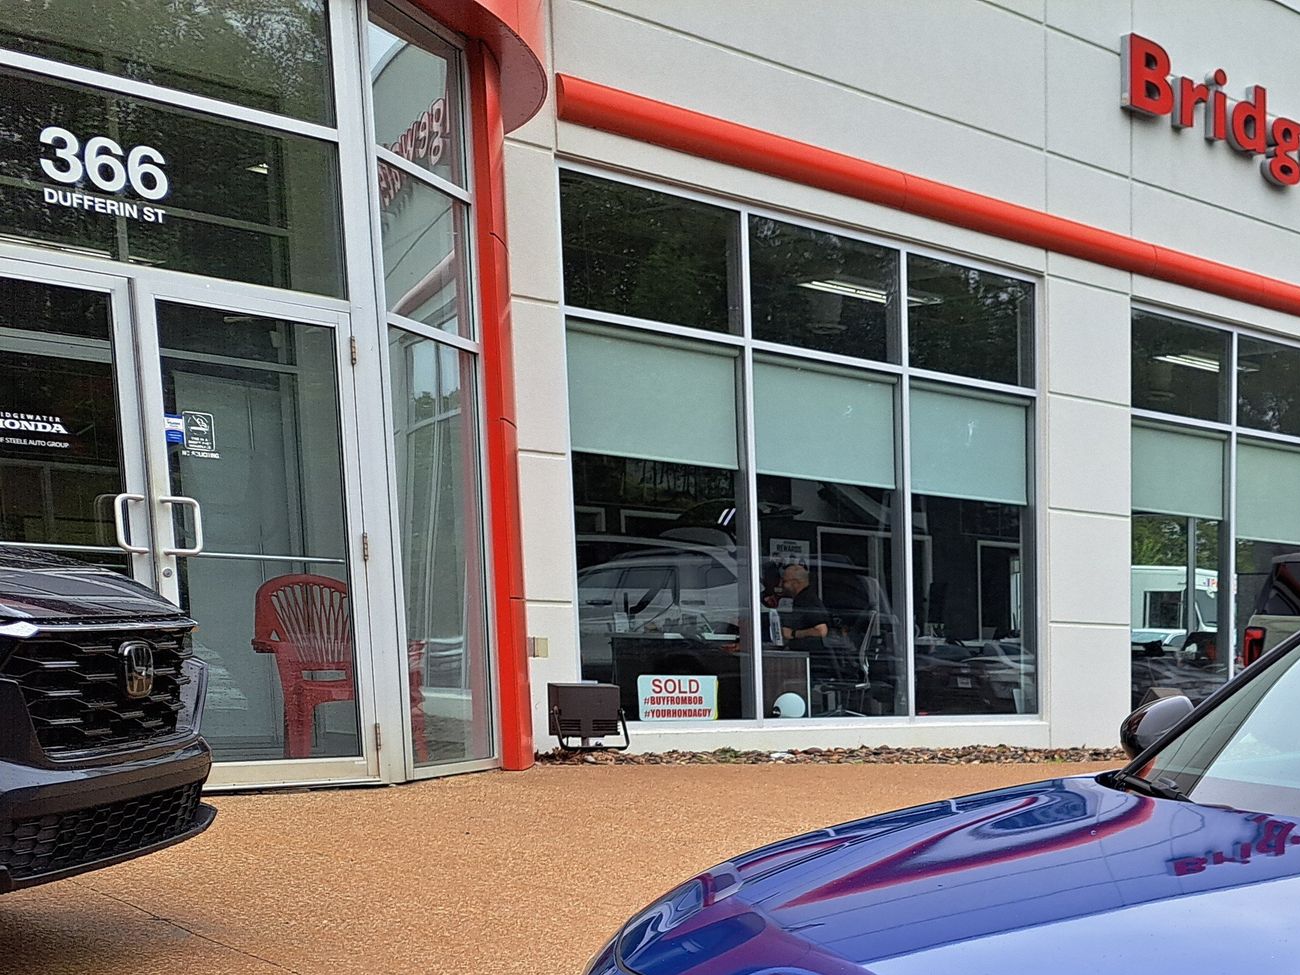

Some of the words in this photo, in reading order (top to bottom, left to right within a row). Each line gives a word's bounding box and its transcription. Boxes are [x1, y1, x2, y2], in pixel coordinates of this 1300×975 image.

[39, 126, 169, 200] 366
[43, 187, 138, 219] DUFFERIN
[143, 206, 166, 224] ST
[28, 439, 46, 447] AUTO
[46, 440, 70, 448] GROUP
[651, 678, 700, 694] SOLD
[643, 695, 704, 705] #BUYFROMBOB
[644, 708, 712, 718] #YOURHONDAGUY
